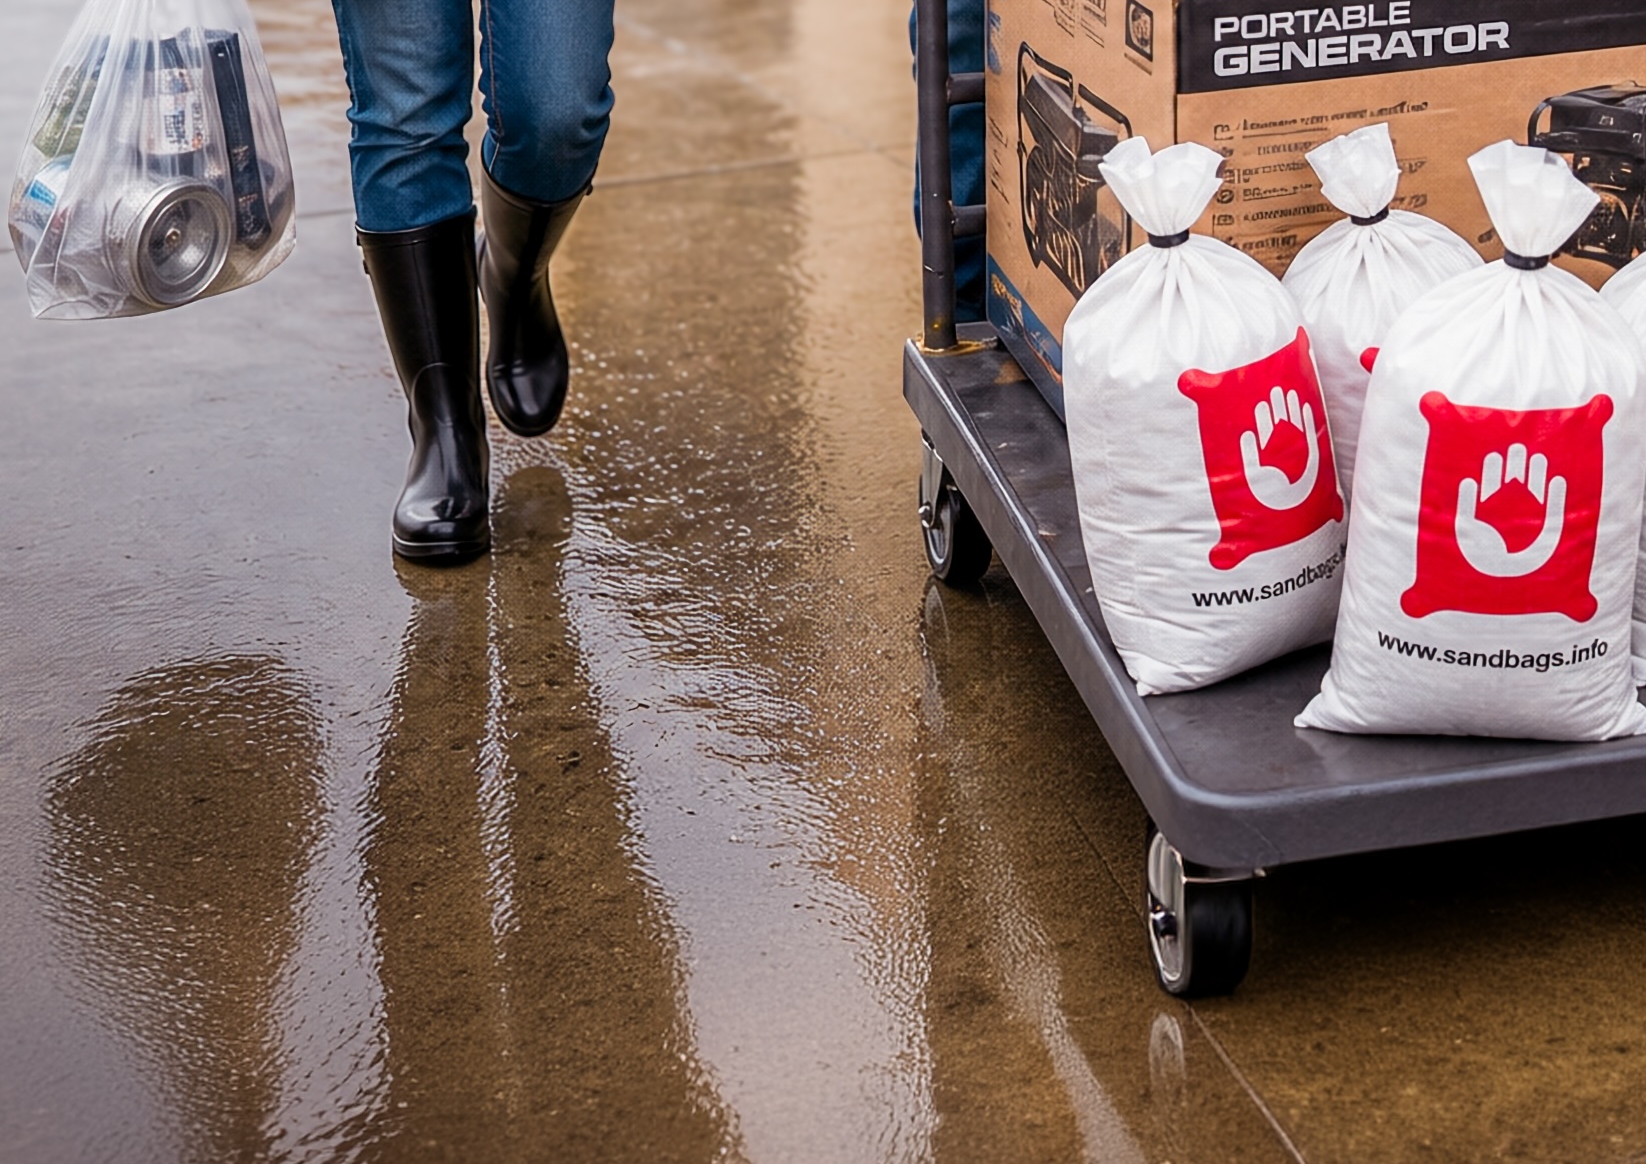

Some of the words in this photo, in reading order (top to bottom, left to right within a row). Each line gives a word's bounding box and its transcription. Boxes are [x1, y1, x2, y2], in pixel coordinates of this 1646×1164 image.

[1214, 0, 1411, 42] PORTABLE
[1213, 21, 1510, 77] GENERATOR
[1377, 630, 1609, 673] www.sandbags.info
